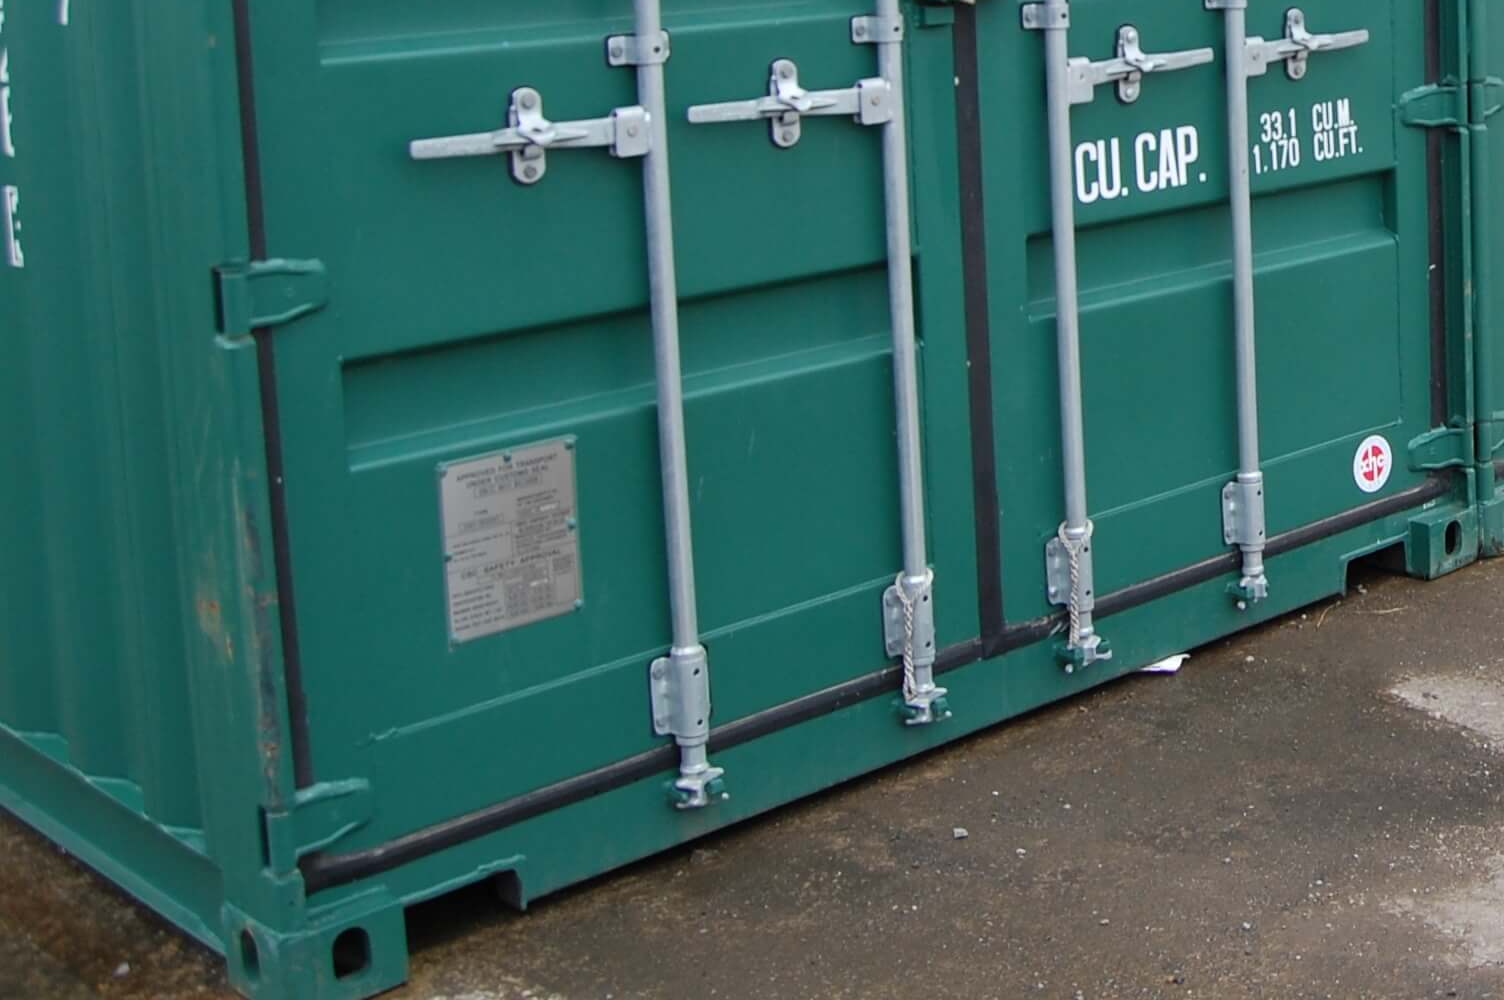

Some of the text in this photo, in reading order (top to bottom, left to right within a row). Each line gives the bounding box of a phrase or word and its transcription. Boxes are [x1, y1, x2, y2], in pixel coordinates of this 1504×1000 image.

[1075, 137, 1129, 204] CU.
[1135, 125, 1207, 193] CAP.
[1260, 107, 1297, 143] 33.1
[1253, 126, 1363, 175] 1.170 CU.FT.
